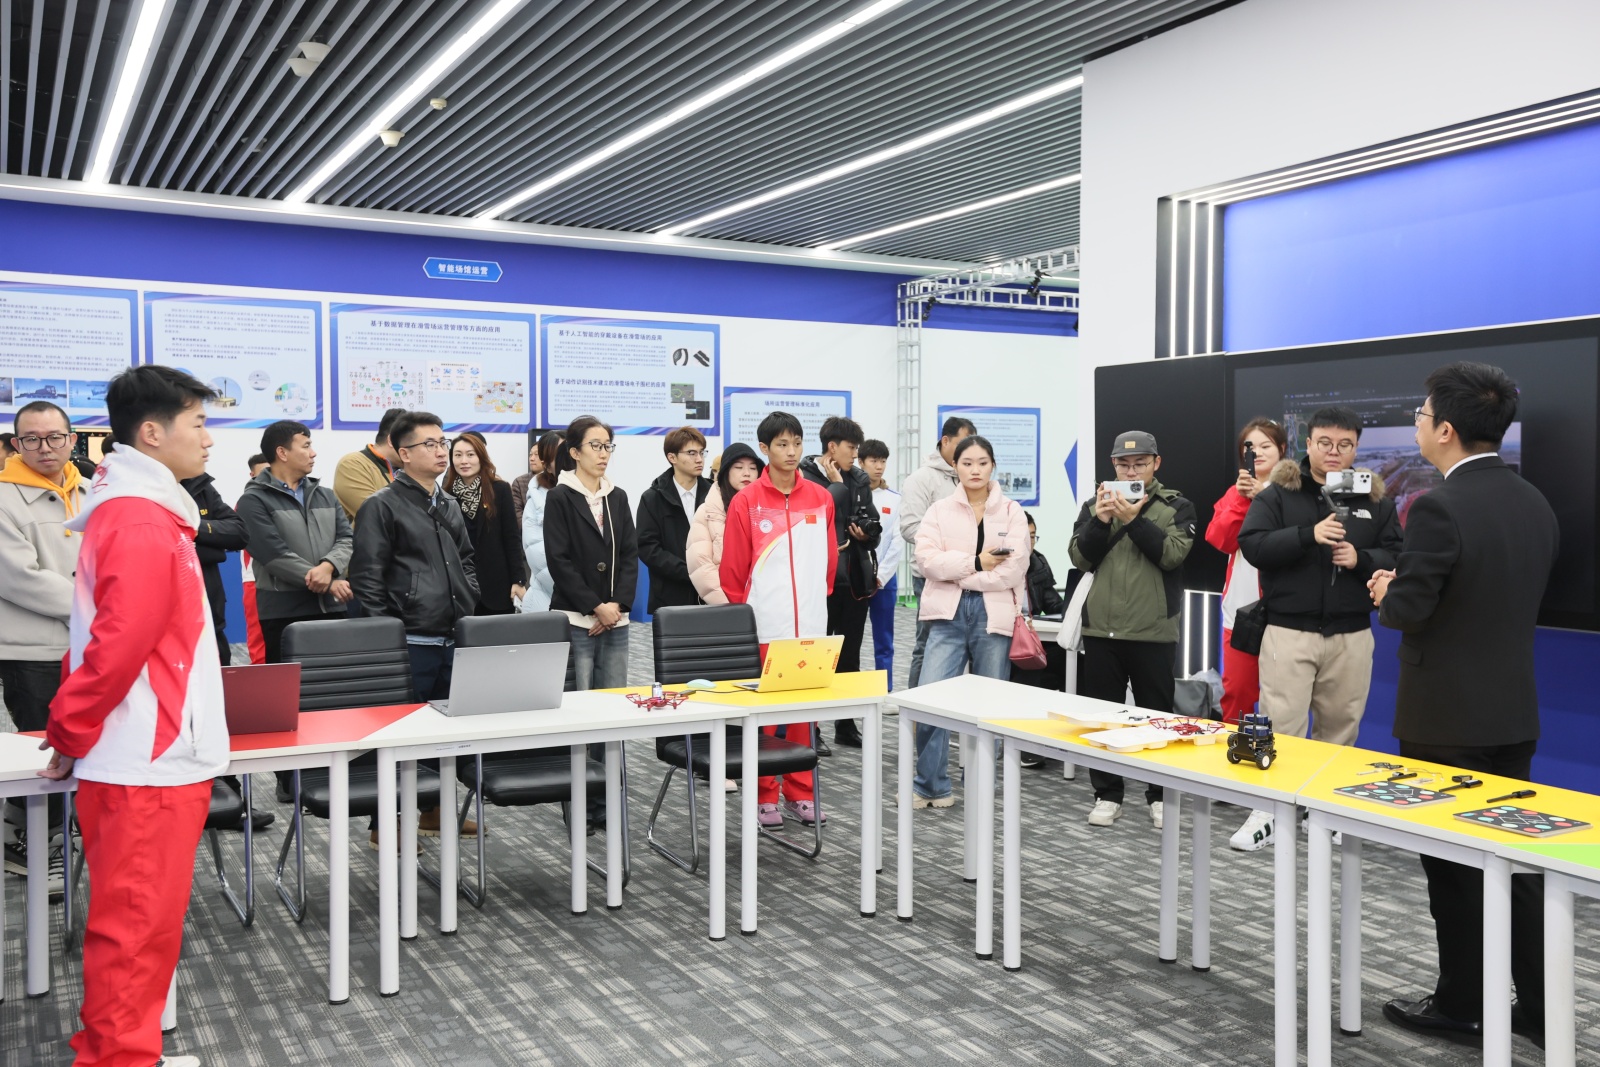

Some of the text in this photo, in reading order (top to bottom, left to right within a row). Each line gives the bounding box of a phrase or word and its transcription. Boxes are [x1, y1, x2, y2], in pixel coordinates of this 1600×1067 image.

[438, 263, 488, 275] 智能场馆运营
[370, 320, 501, 333] 基于数据管理在滑雪场运营管理等方面的应用
[558, 329, 663, 341] 基于人工智能的穿戴设备在滑雪场的应用
